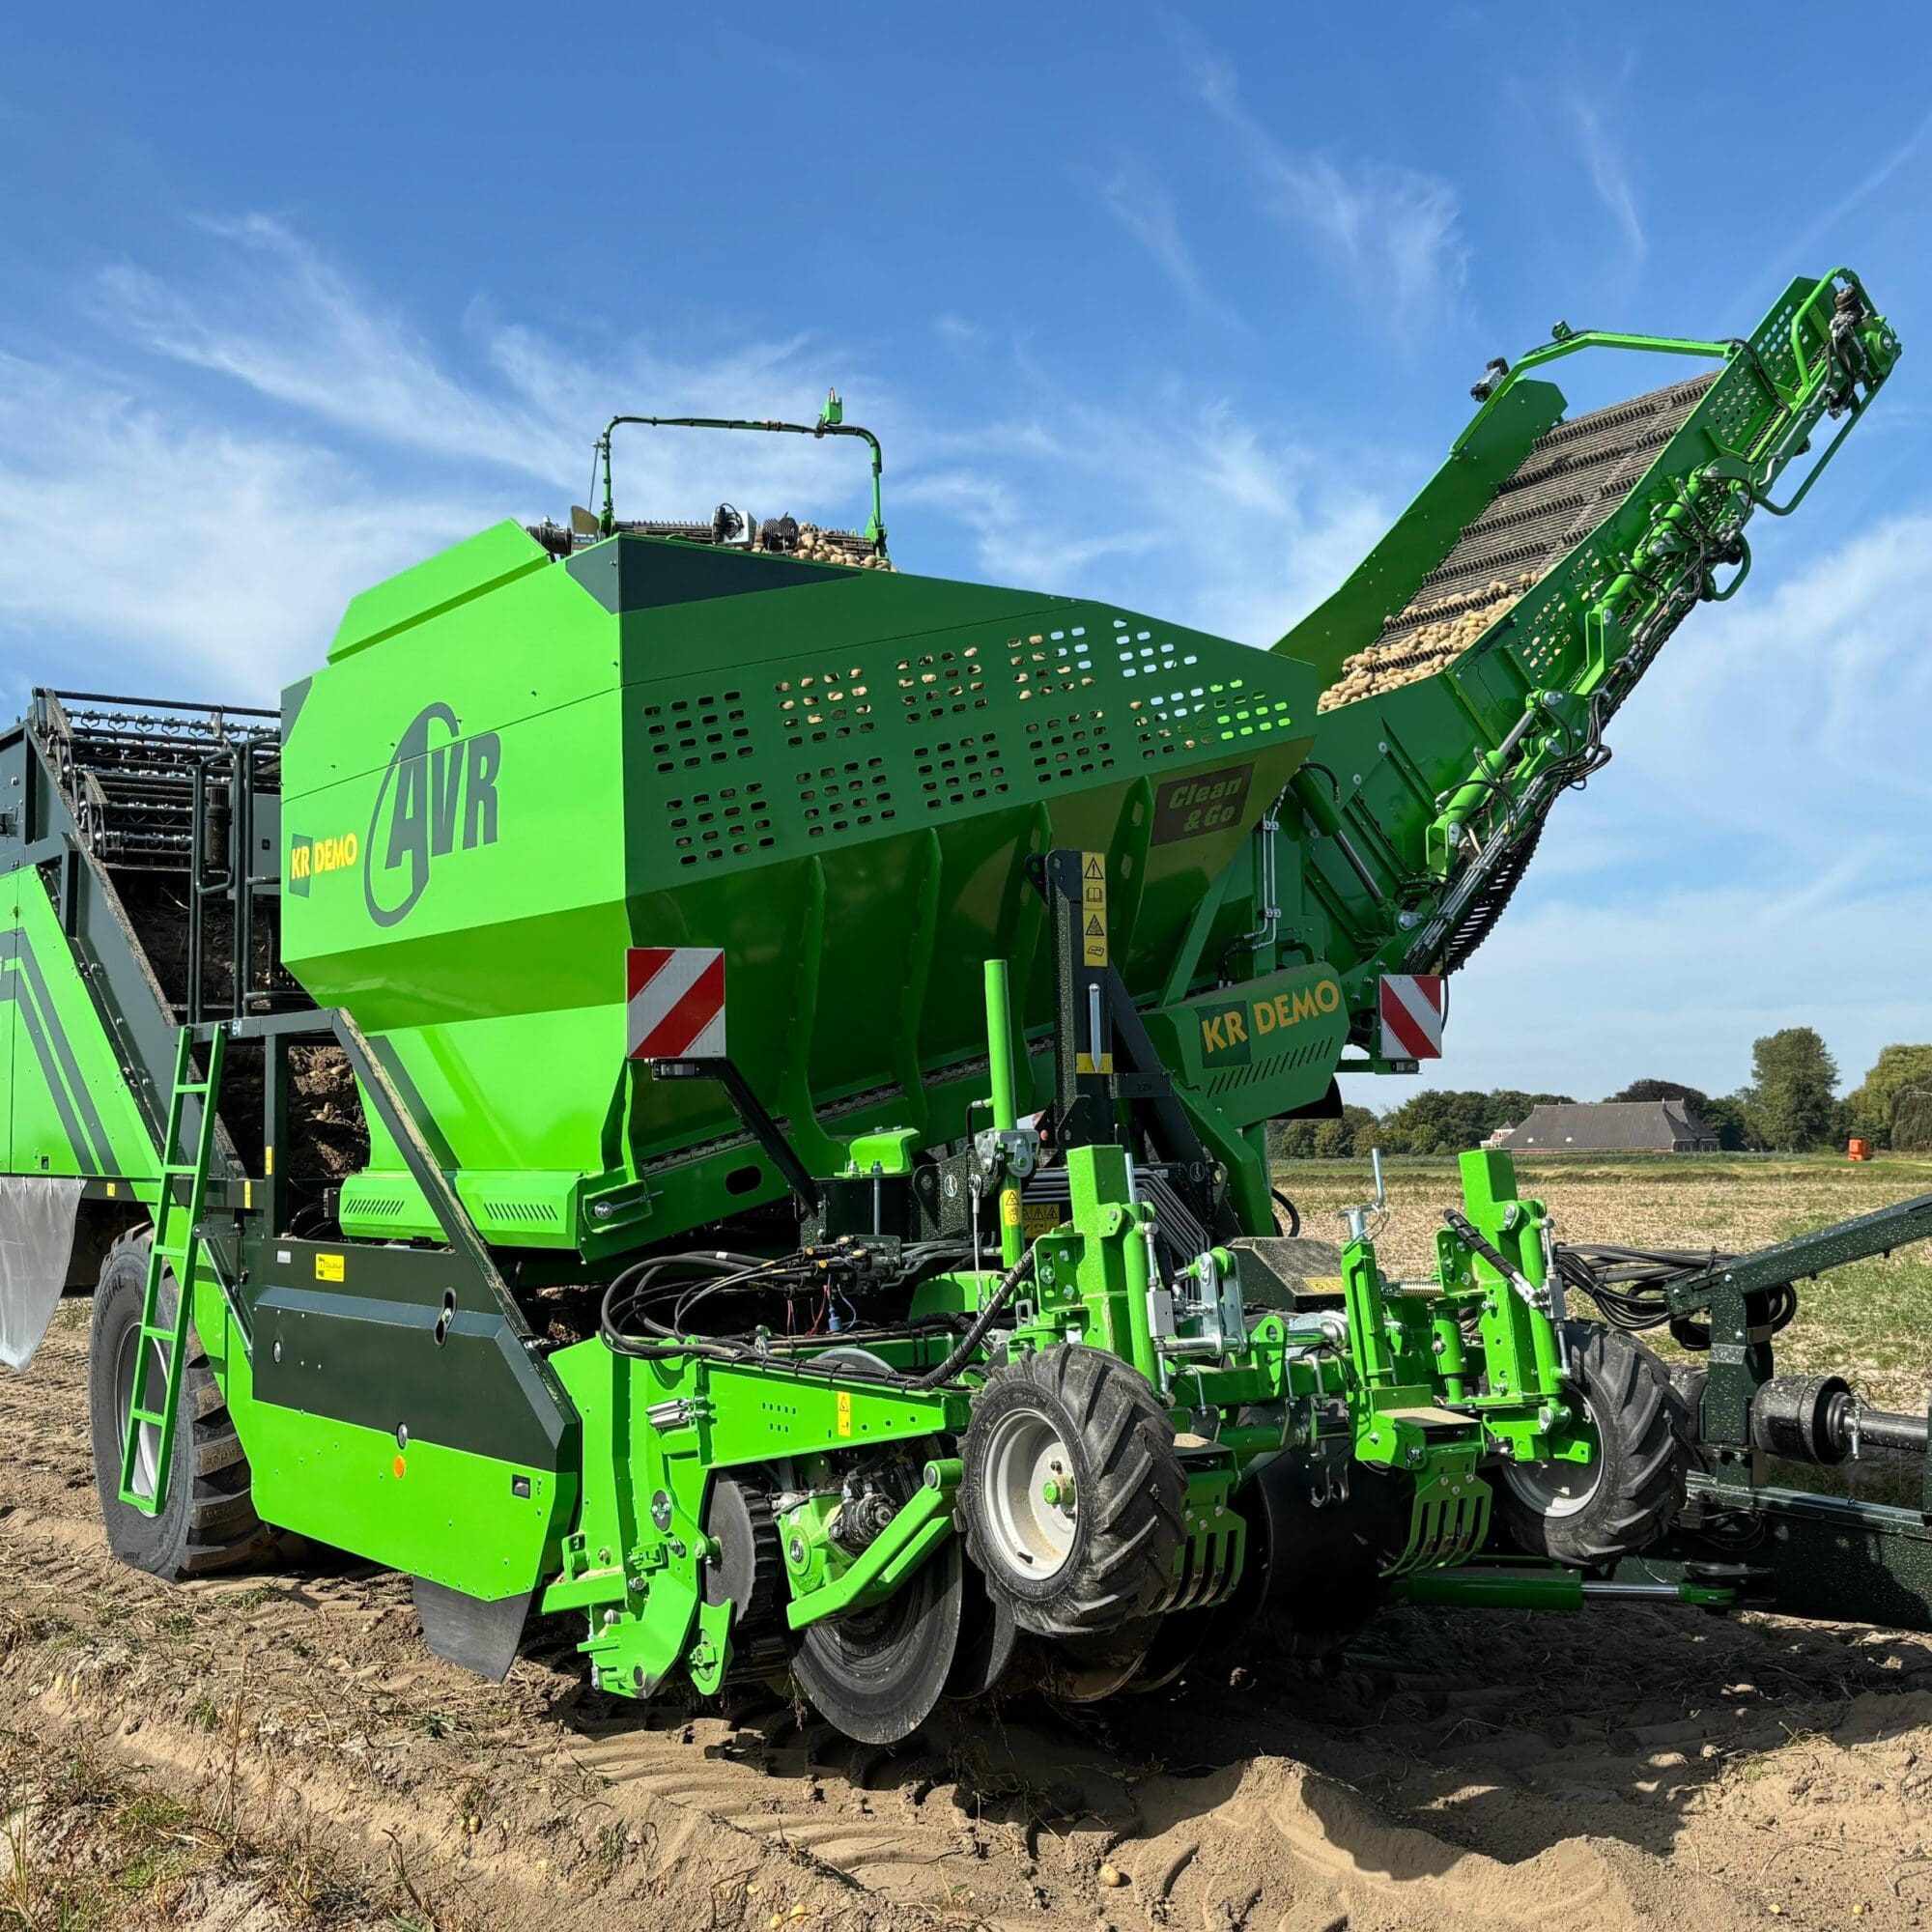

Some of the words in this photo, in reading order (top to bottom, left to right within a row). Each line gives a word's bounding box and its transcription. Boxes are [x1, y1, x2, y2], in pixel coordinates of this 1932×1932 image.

[364, 701, 501, 927] AVR
[1169, 777, 1242, 809] Clean
[1183, 810, 1202, 832] &
[1204, 804, 1236, 827] Go
[291, 845, 310, 880] KR
[314, 833, 357, 874] DEMO
[1202, 1010, 1248, 1053] KR
[1253, 980, 1340, 1036] DEMO
